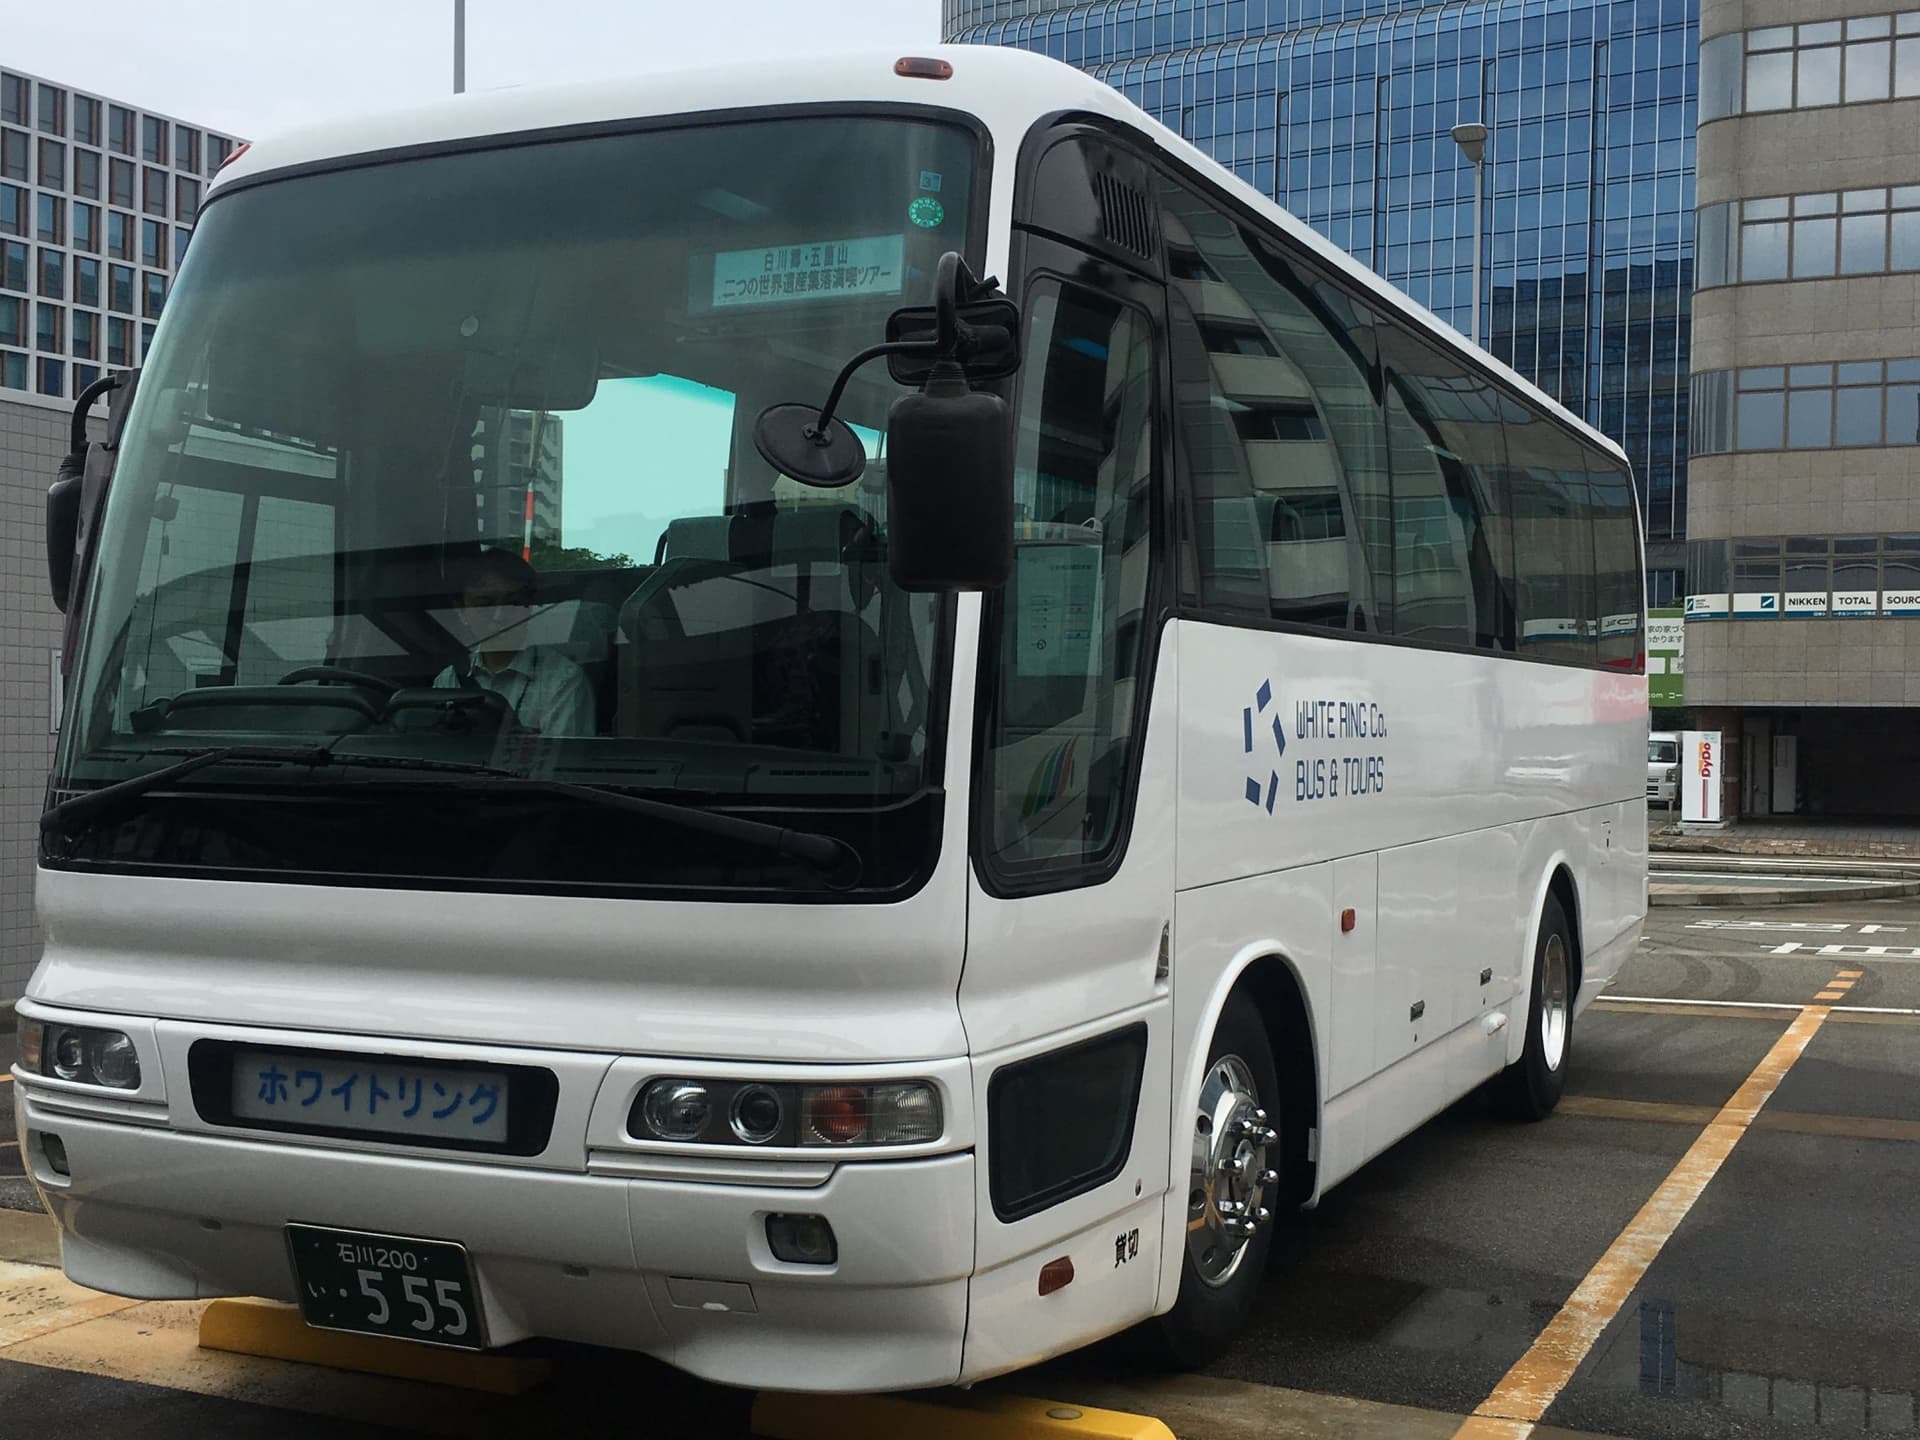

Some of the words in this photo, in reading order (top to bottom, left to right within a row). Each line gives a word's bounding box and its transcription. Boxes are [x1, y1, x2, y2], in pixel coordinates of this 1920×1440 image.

[1788, 597, 1825, 606] NIKKEN
[1838, 596, 1872, 605] TOTAL
[1296, 700, 1335, 739] WHITE
[1340, 702, 1367, 738] RING
[1370, 703, 1387, 738] Co.
[1296, 759, 1325, 801] BUS
[1329, 758, 1338, 797] &
[1343, 756, 1384, 796] TOURS
[1701, 742, 1713, 777] DyDo
[258, 1066, 498, 1124] ホワイトリング
[1115, 1228, 1139, 1269] 貸切
